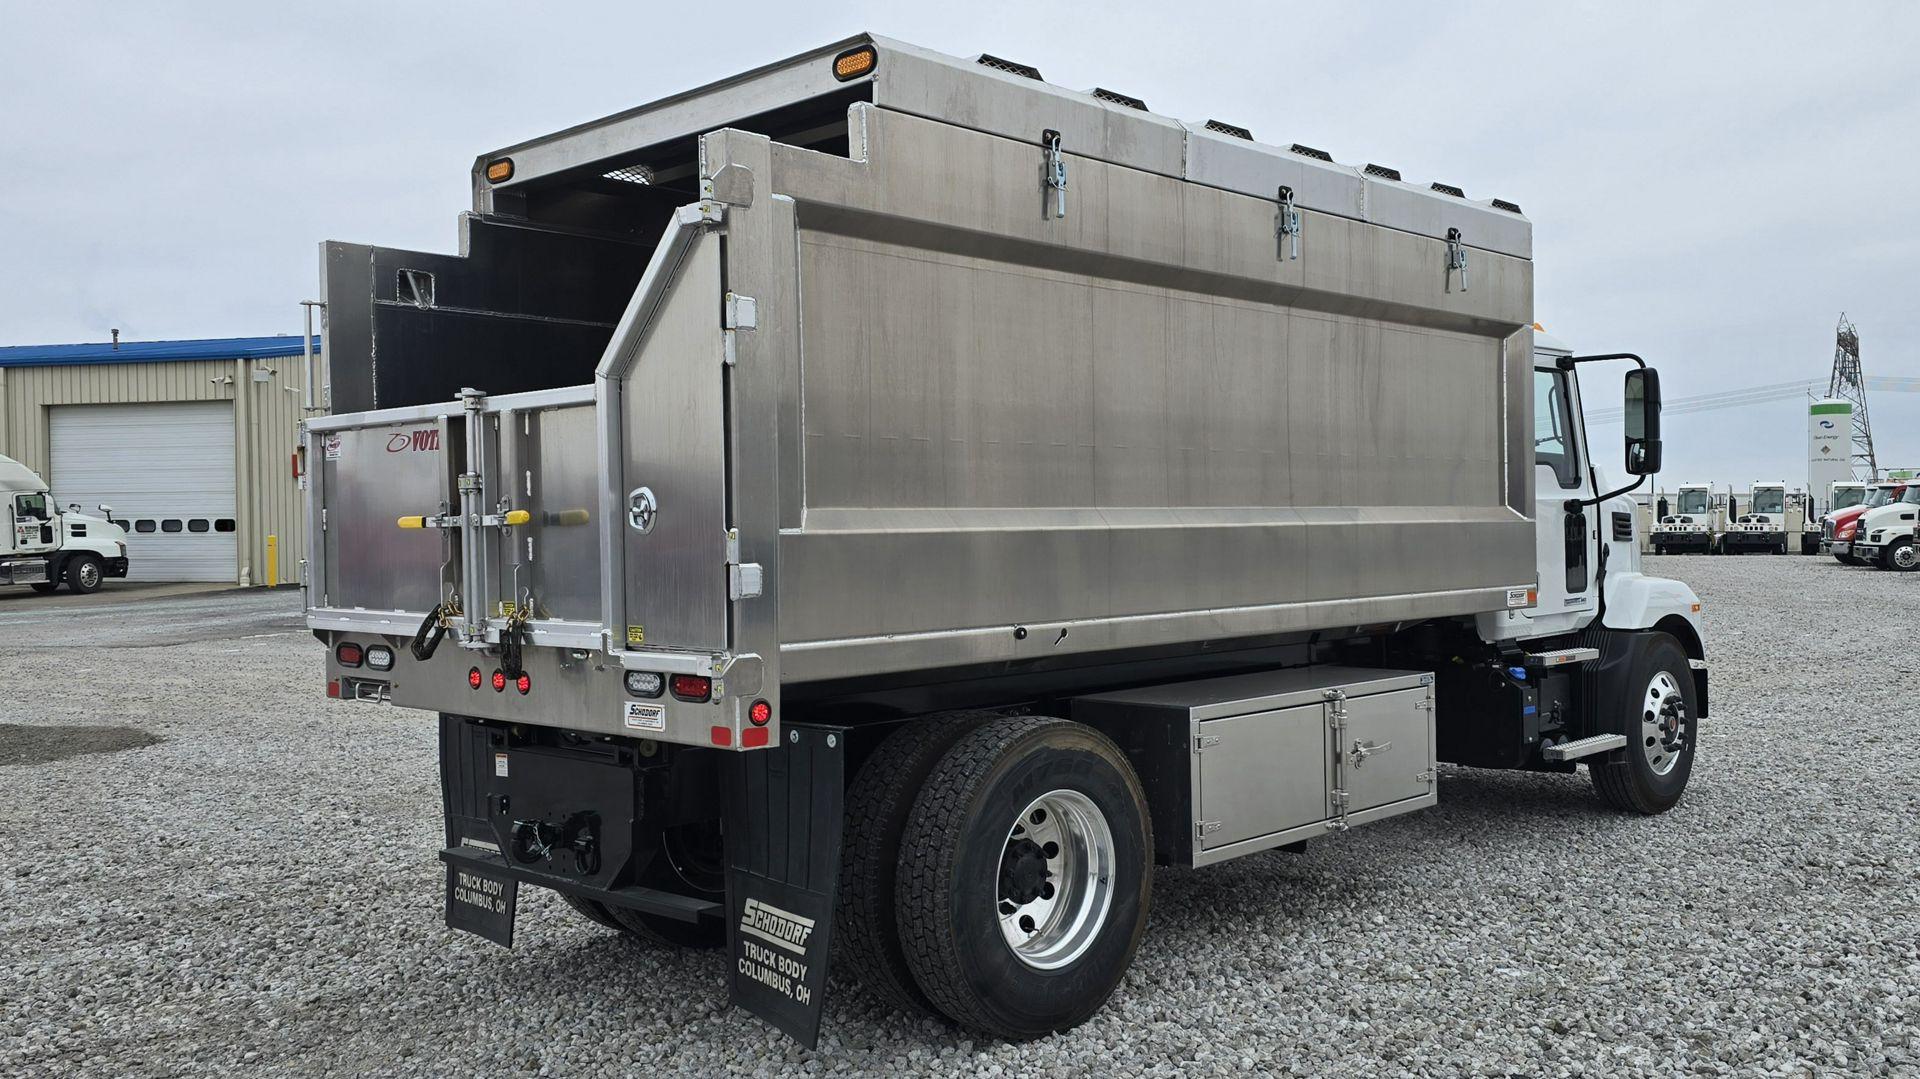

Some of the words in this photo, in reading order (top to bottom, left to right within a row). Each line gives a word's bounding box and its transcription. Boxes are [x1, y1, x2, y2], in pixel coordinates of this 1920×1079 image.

[629, 704, 660, 718] SCHODORF
[454, 886, 494, 913] COLUMBUS,
[495, 899, 507, 915] OH
[458, 872, 482, 891] TRUCK
[482, 878, 504, 897] BODY
[741, 897, 812, 946] SCHODORF
[743, 940, 777, 969] TRUCK
[778, 955, 808, 982] BODY
[738, 957, 794, 999] COLUMBUS,
[795, 984, 811, 1006] OH
